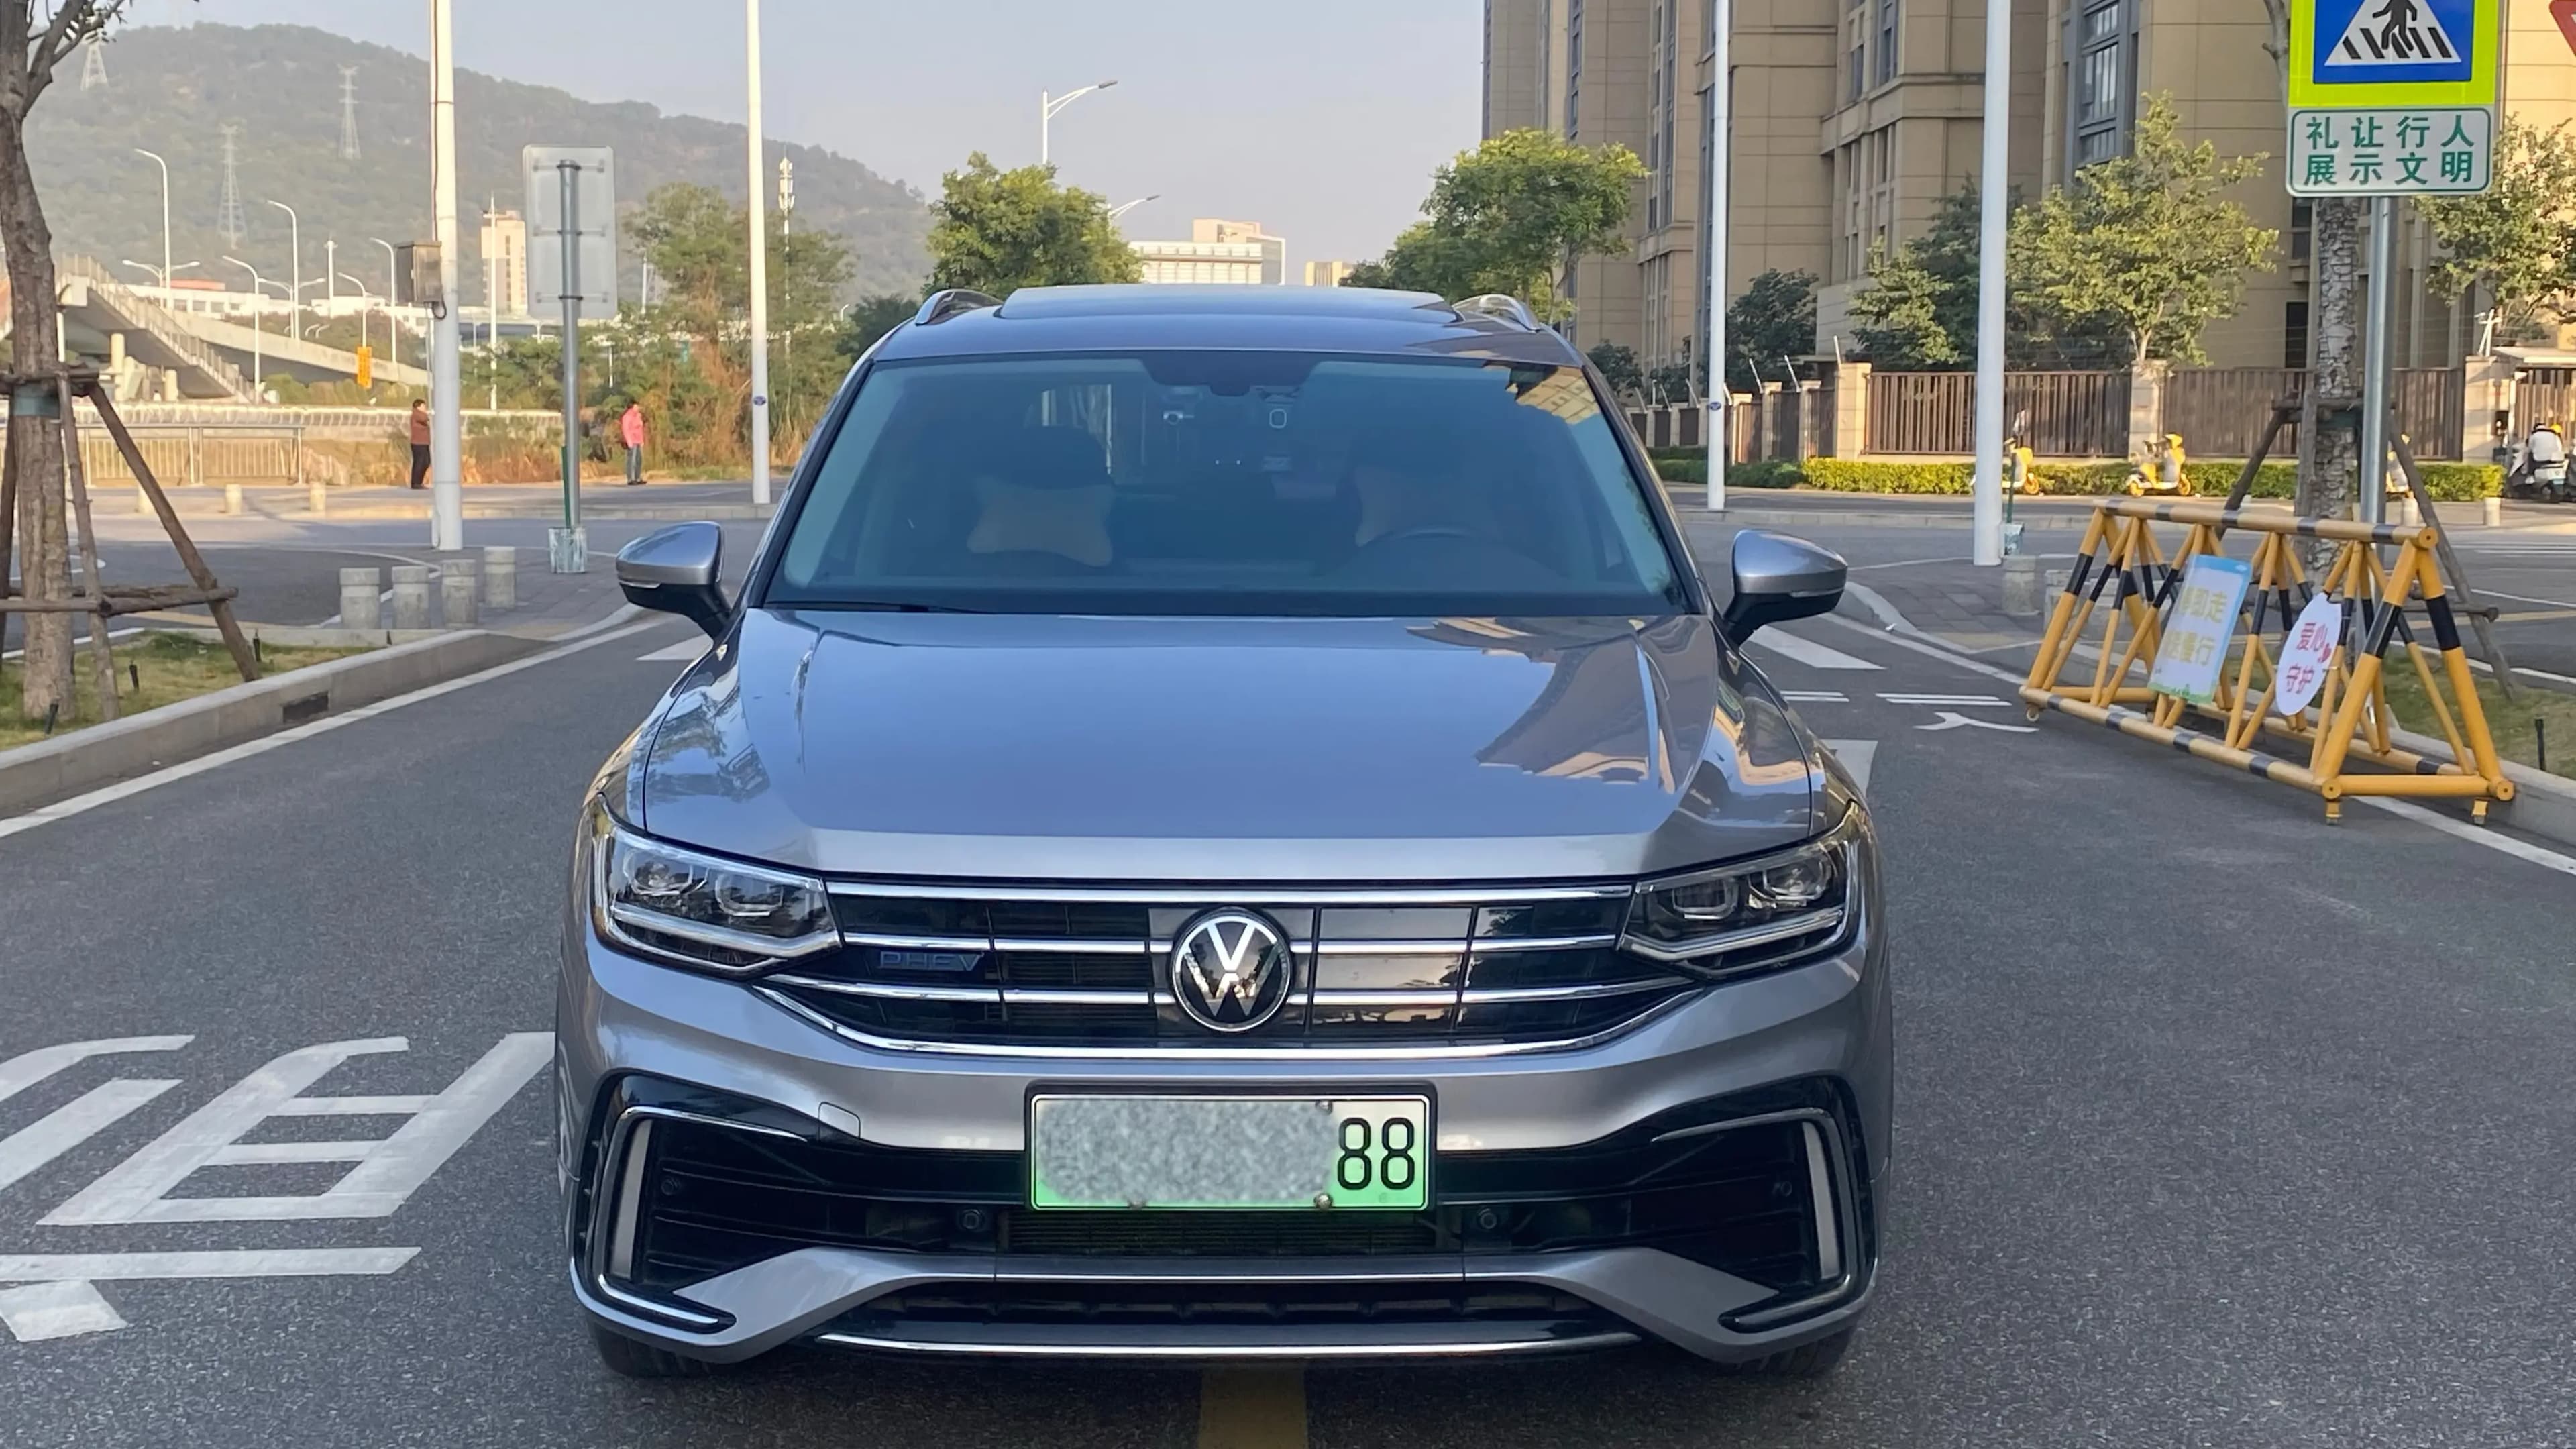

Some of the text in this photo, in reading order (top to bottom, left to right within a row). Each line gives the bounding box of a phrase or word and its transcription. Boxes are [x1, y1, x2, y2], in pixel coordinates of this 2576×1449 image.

[2306, 115, 2475, 150] 礼让行人
[2303, 151, 2473, 186] 展示文明
[879, 951, 985, 972] PHEV
